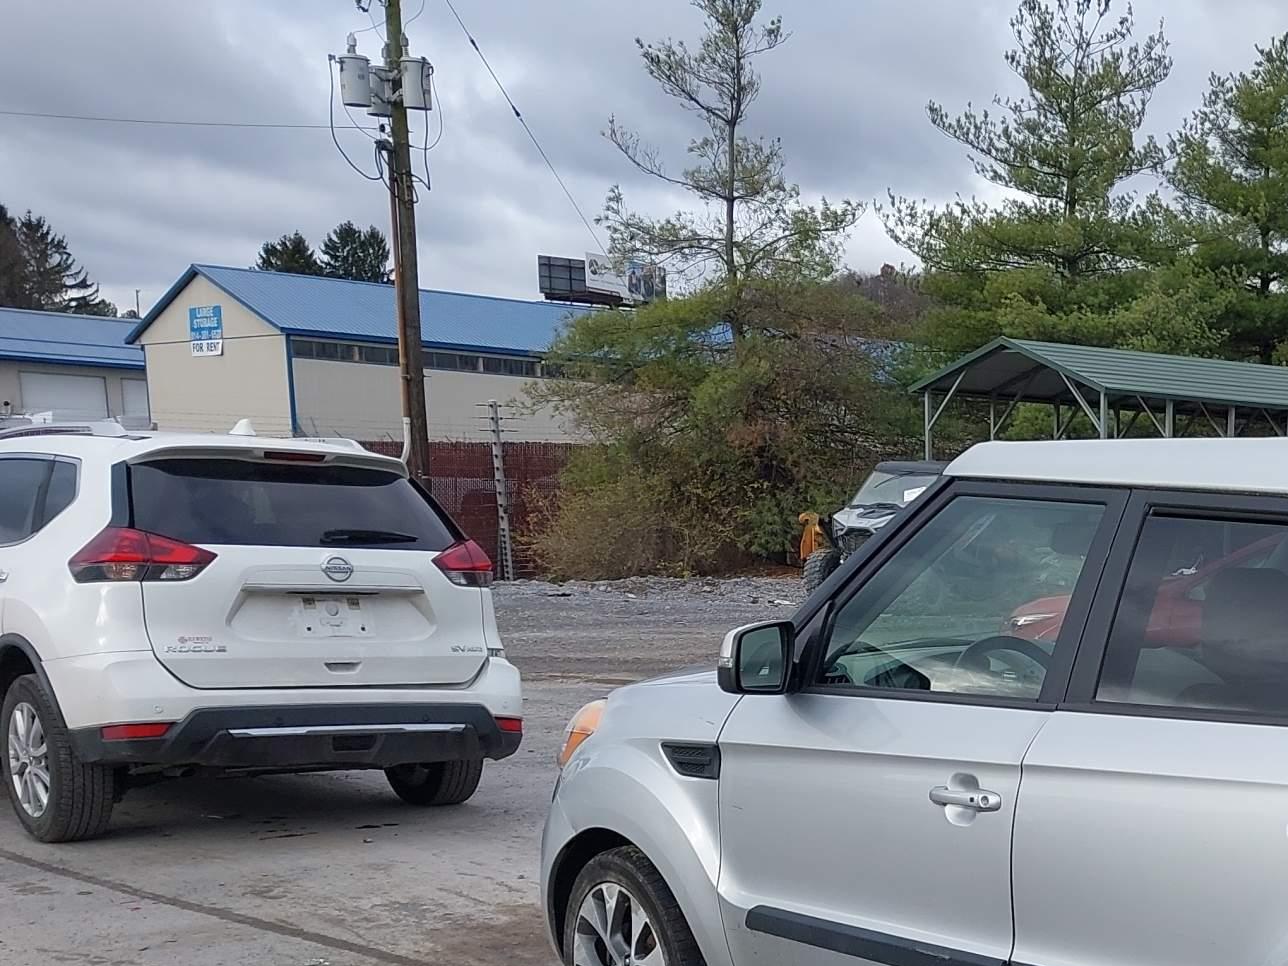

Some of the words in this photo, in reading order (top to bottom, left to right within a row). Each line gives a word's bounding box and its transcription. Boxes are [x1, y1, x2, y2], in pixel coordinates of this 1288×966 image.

[193, 317, 219, 329] STORAGE
[192, 342, 204, 353] FOR
[206, 341, 221, 352] RENT
[164, 644, 227, 654] ROGUE
